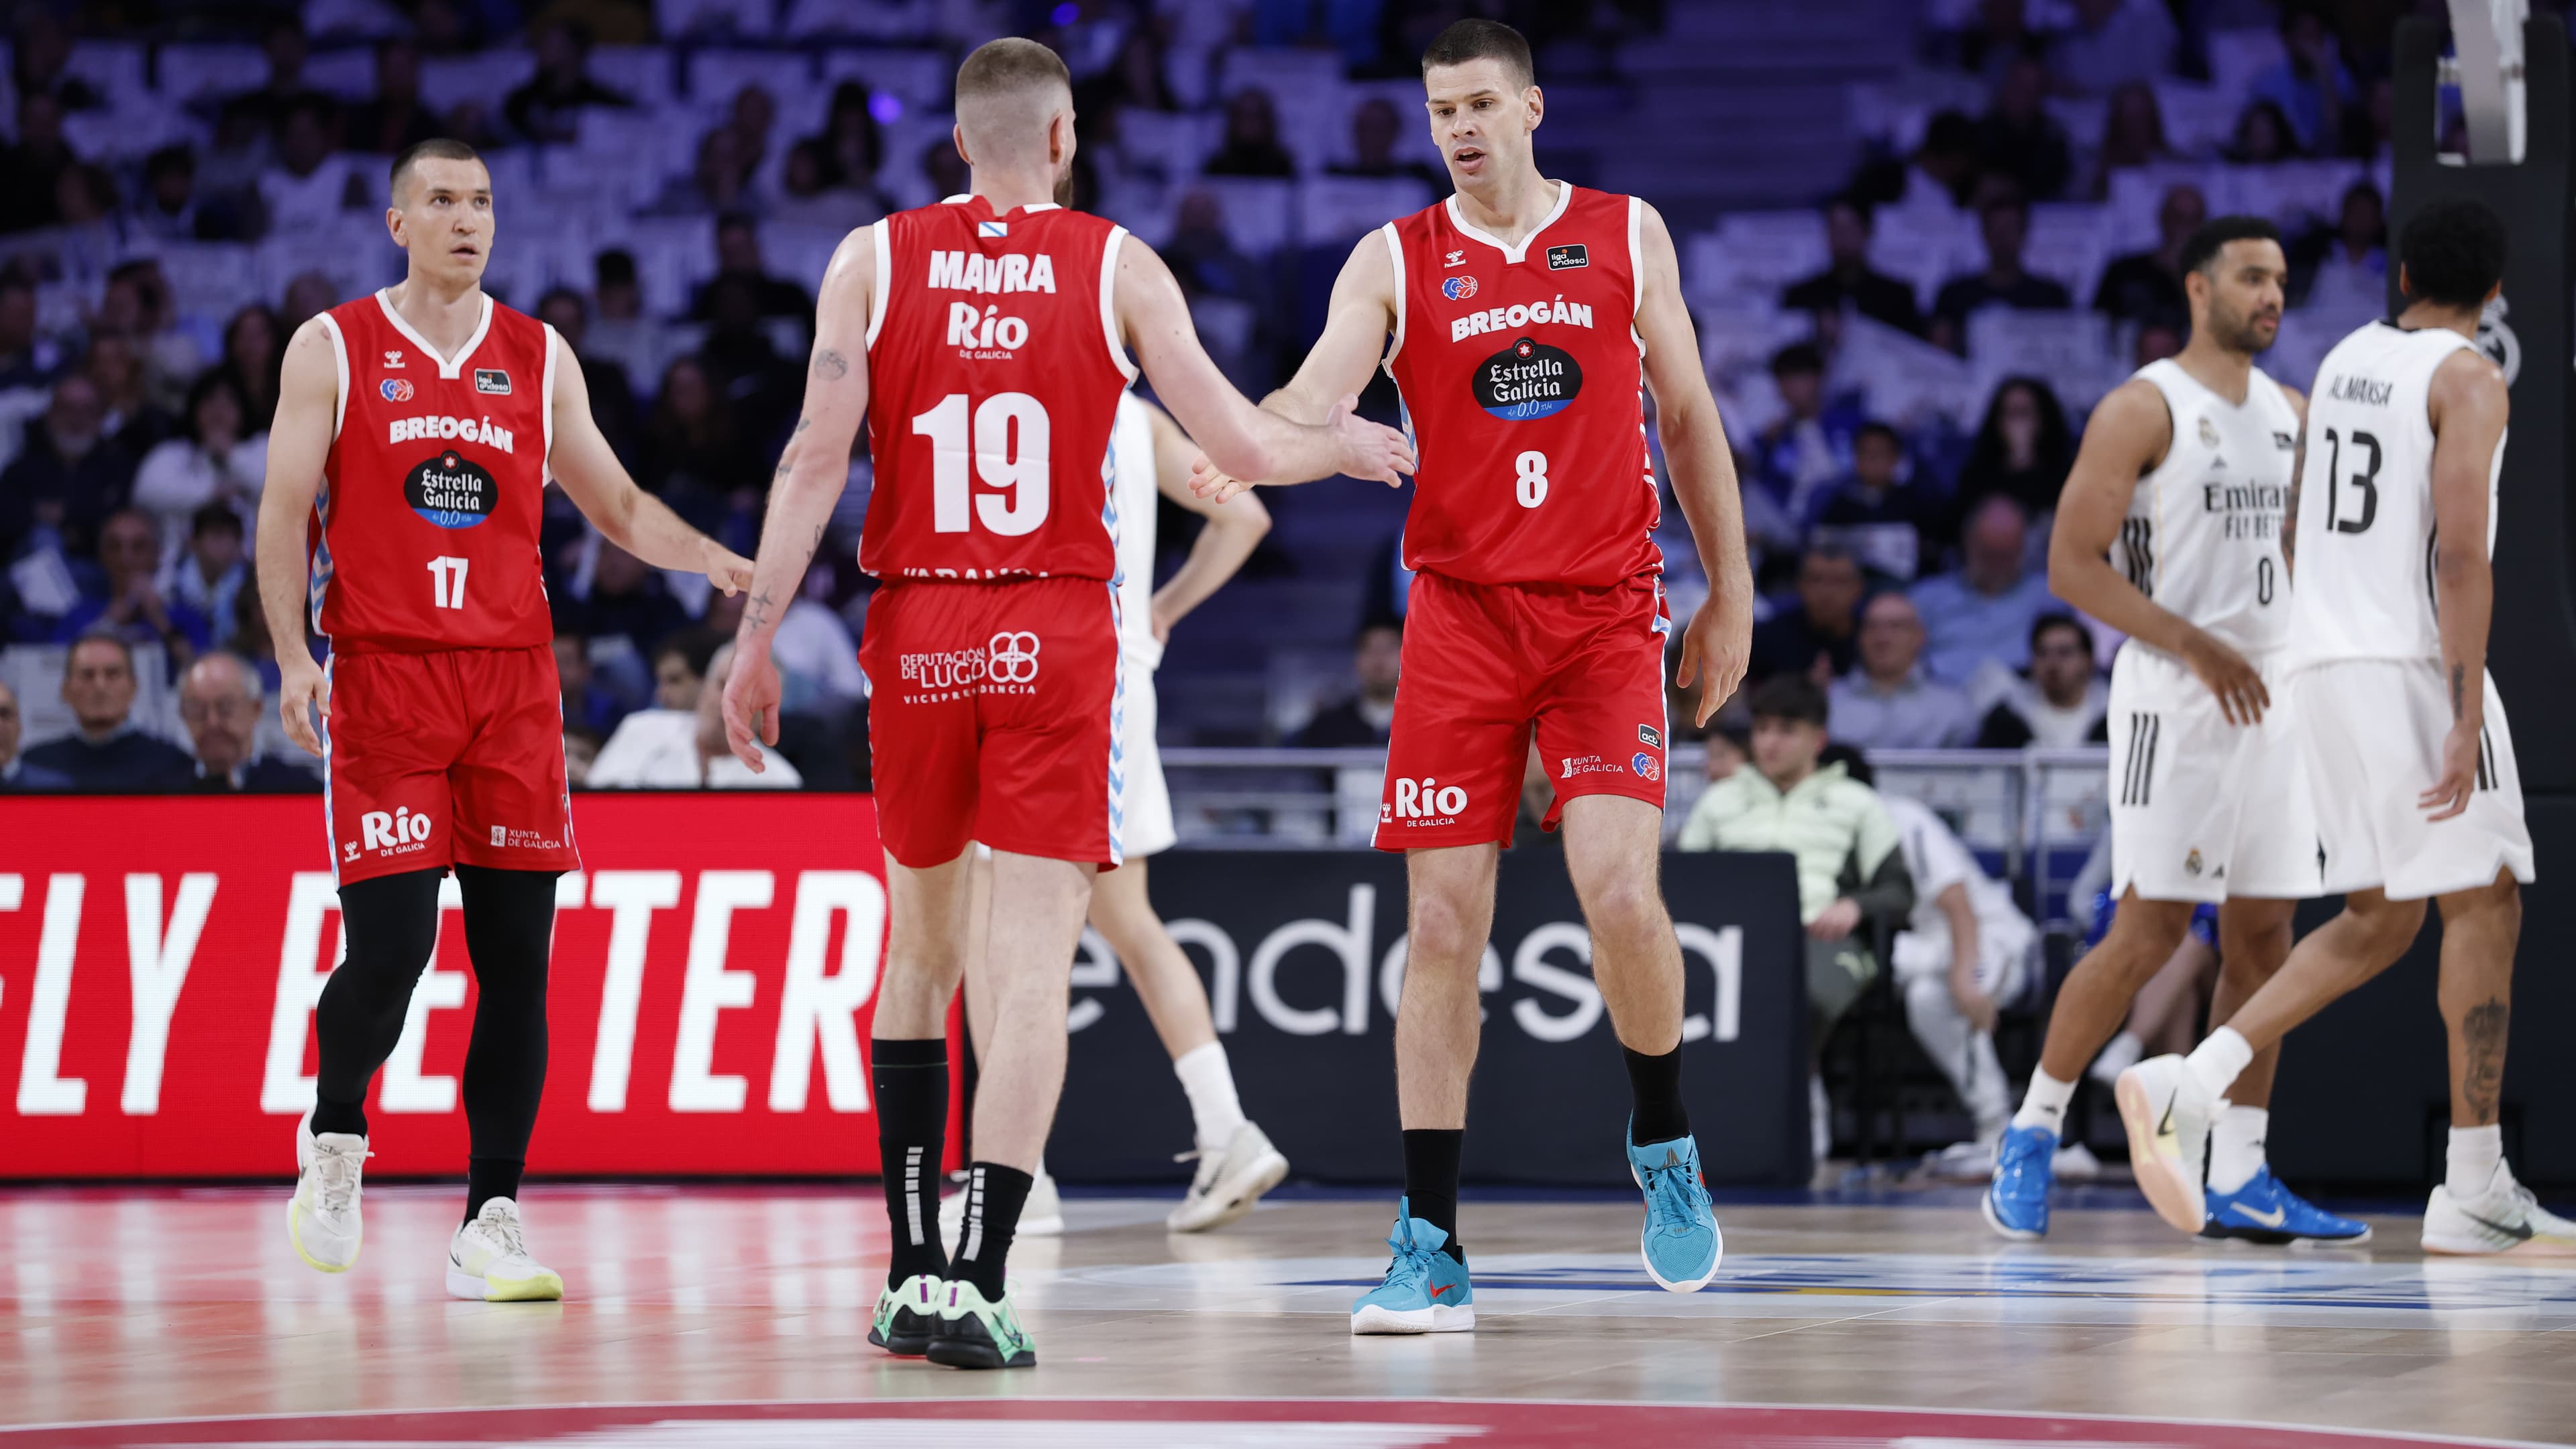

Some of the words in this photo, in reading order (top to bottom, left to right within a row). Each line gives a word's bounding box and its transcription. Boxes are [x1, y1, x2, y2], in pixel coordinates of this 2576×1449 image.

[1551, 252, 1567, 260] liga
[1552, 258, 1585, 266] endesa
[928, 250, 1057, 294] MAVRA
[947, 302, 1029, 350] Río
[1451, 294, 1593, 343] BREOGÁN
[959, 350, 972, 359] DE
[975, 350, 1012, 360] GALICIA
[1489, 358, 1564, 382] Estrella
[1494, 378, 1562, 402] Galicia
[390, 415, 513, 454] BREOGÁN
[912, 392, 1050, 536] 19
[421, 468, 482, 492] Estrella
[1515, 450, 1548, 508] 8
[2326, 427, 2381, 534] 13
[424, 488, 480, 511] Galicia
[427, 555, 469, 609] 17
[2258, 557, 2273, 605] 0
[900, 647, 985, 667] DEPUTACIÓN
[902, 666, 918, 680] DE
[920, 658, 986, 688] LUGO
[1642, 733, 1658, 745] acb
[1572, 755, 1601, 765] XUNTA
[1573, 767, 1580, 775] DE
[1582, 764, 1623, 773] GALICIA
[1396, 777, 1468, 818] Río
[362, 806, 431, 851] Río
[509, 828, 540, 839] XUNTA
[1419, 818, 1455, 826] GALICIA
[380, 848, 394, 857] DE
[396, 842, 425, 854] GALICIA
[508, 838, 521, 847] DE
[523, 839, 561, 849] GALICIA
[260, 871, 887, 1114] BETER
